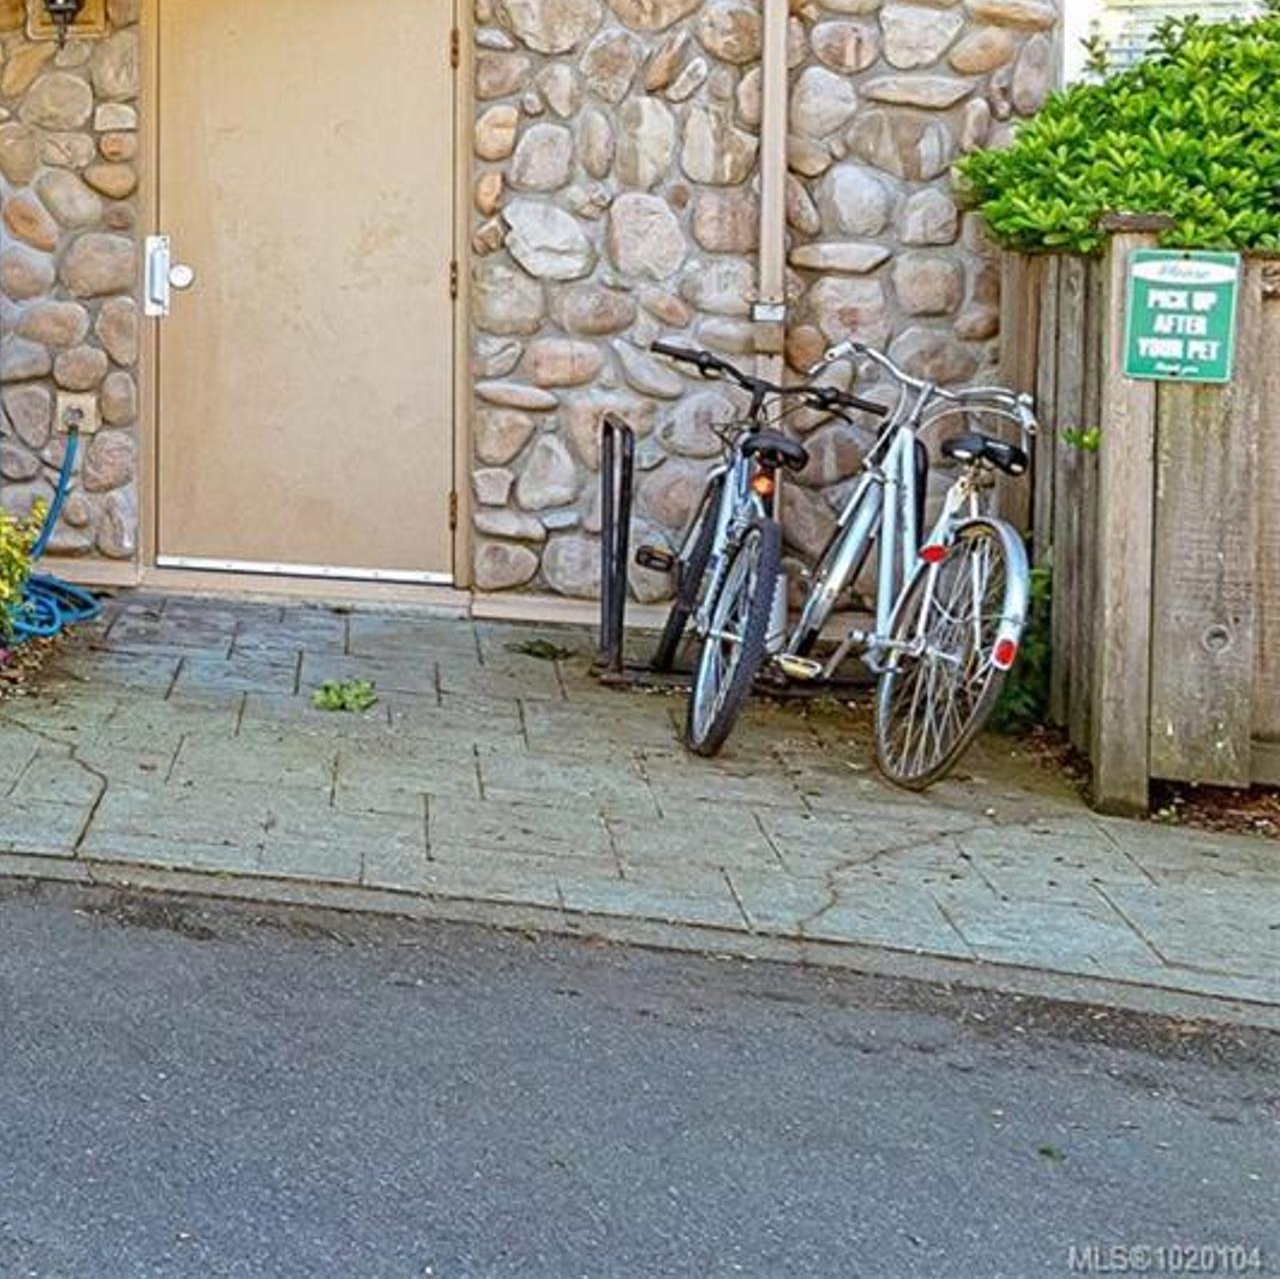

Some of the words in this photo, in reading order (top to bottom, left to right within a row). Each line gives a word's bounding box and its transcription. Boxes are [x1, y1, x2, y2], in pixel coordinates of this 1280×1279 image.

[1148, 288, 1189, 309] PICK
[1192, 290, 1218, 312] UP
[1153, 314, 1208, 335] AFTER
[1138, 337, 1184, 359] YOUR
[1187, 340, 1221, 361] PET
